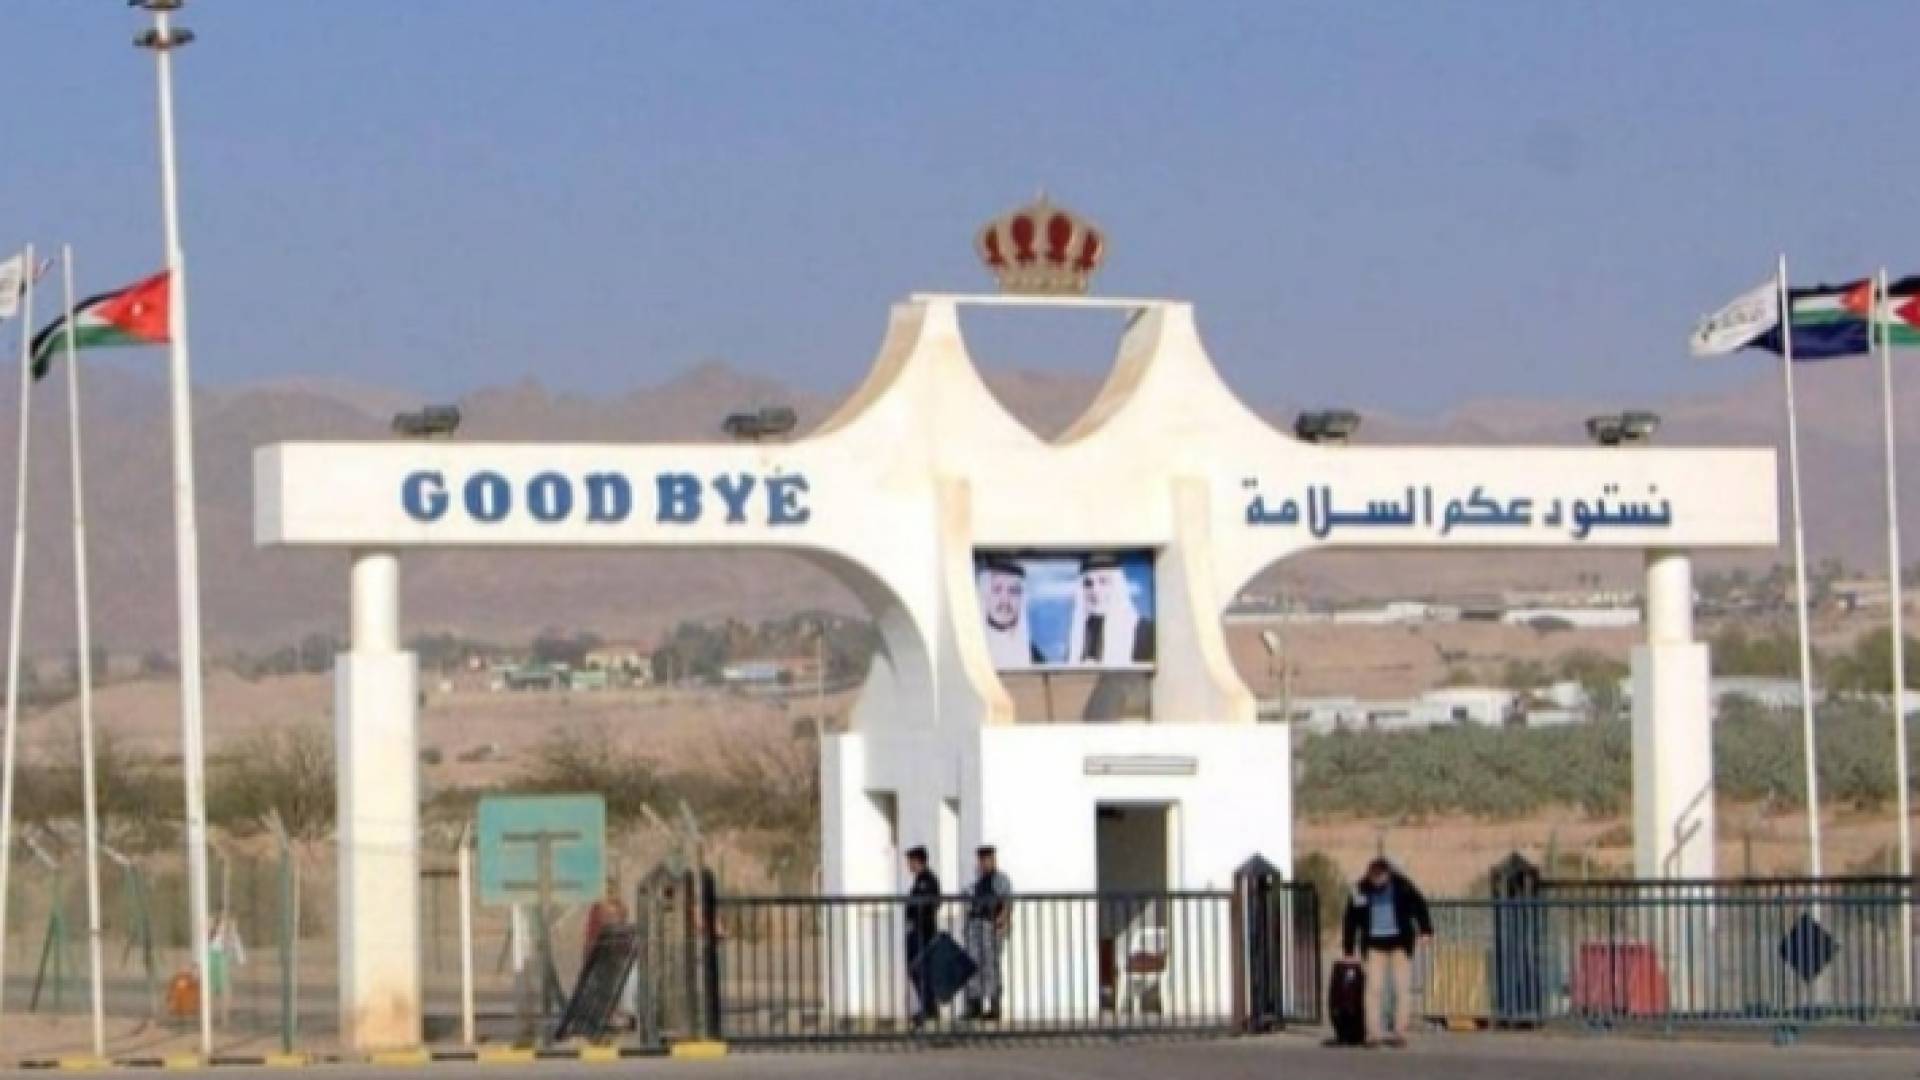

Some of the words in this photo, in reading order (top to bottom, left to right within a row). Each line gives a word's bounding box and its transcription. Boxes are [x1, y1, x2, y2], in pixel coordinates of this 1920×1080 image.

[400, 469, 633, 524] GOOD
[655, 471, 811, 525] BYE
[1241, 477, 1434, 540] السلامة
